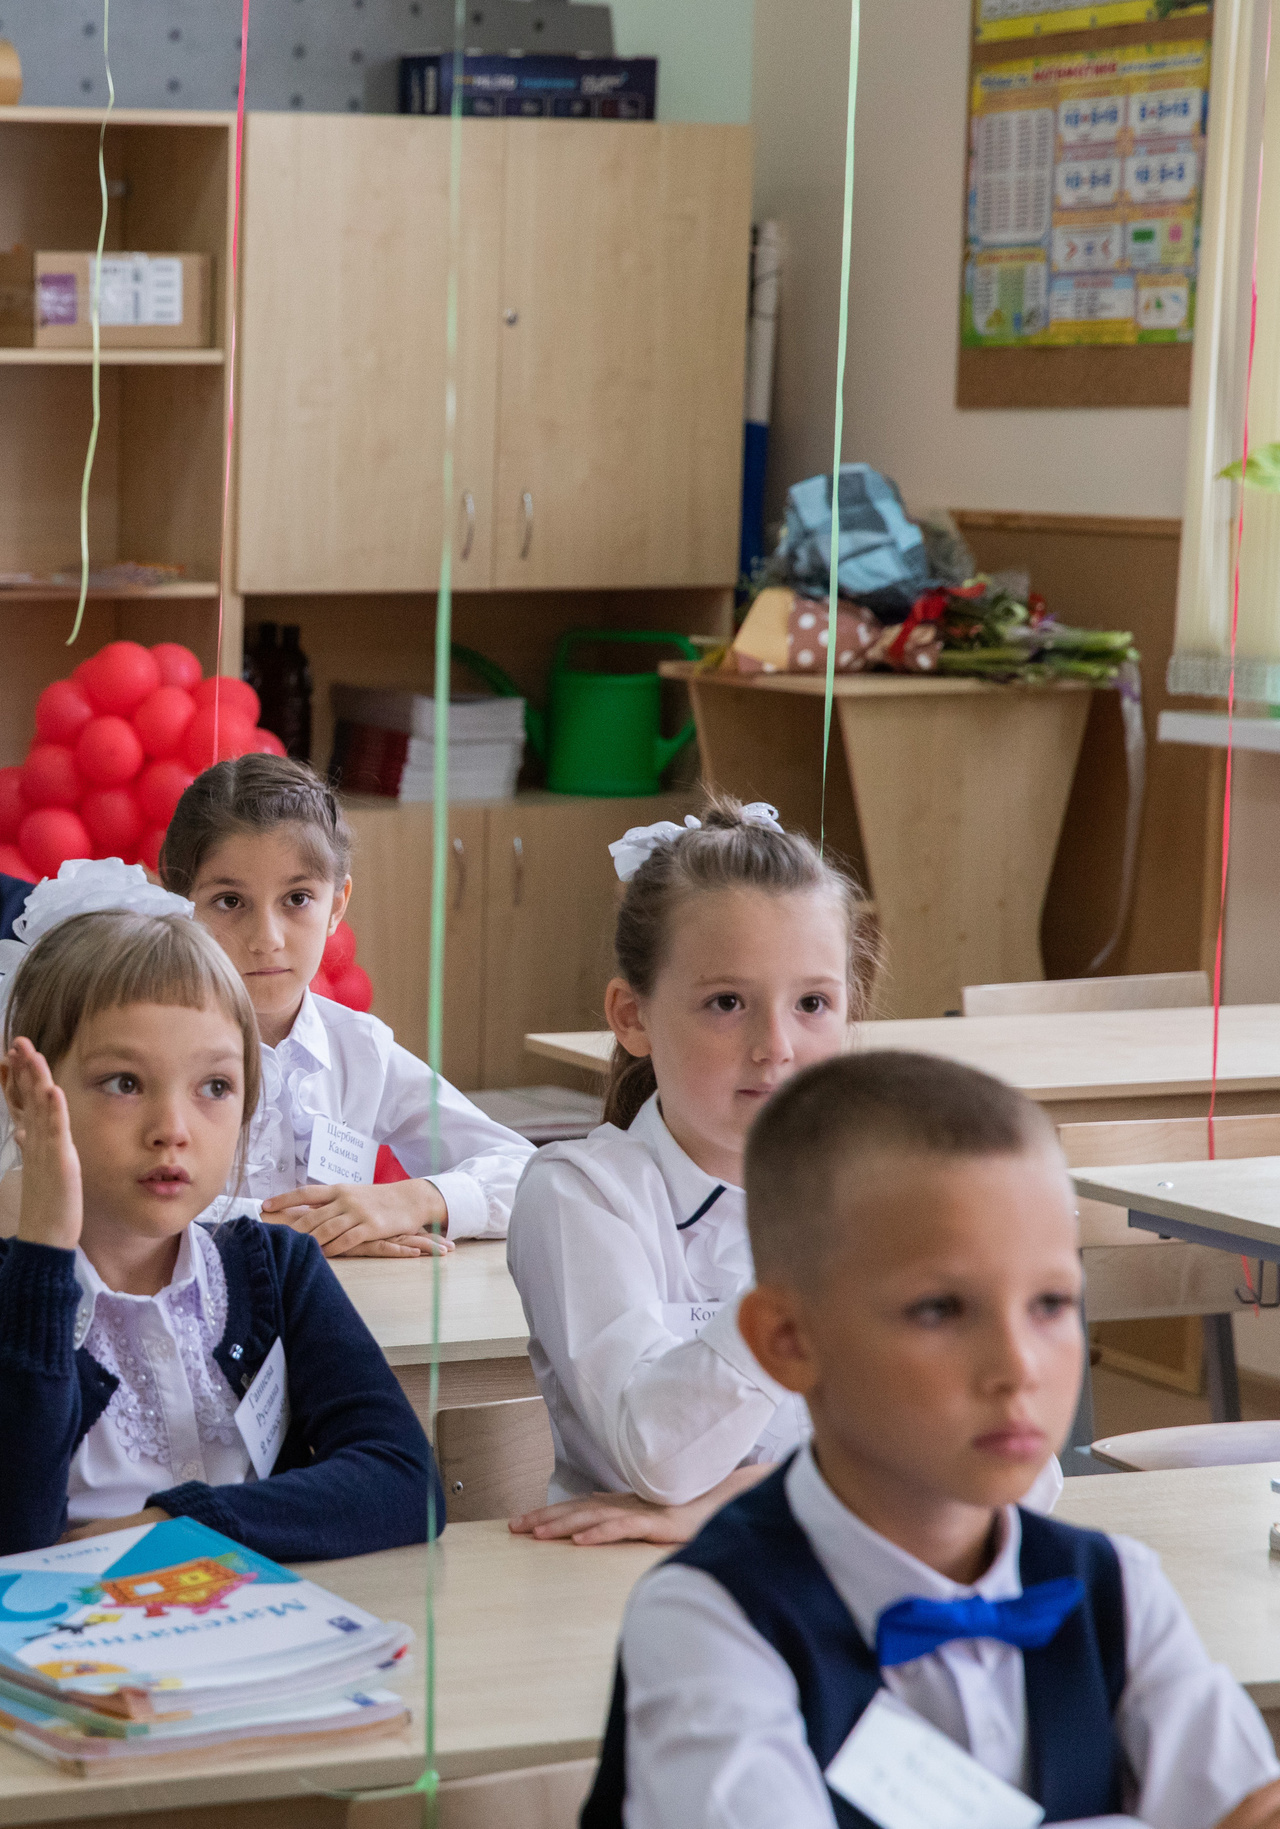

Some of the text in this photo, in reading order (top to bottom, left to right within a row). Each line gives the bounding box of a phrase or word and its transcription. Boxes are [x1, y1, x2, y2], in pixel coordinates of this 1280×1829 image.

[327, 1122, 364, 1149] Щербина
[328, 1140, 358, 1163] Камила
[319, 1156, 326, 1167] 2
[327, 1162, 350, 1178] класс
[52, 1597, 308, 1651] Математика
